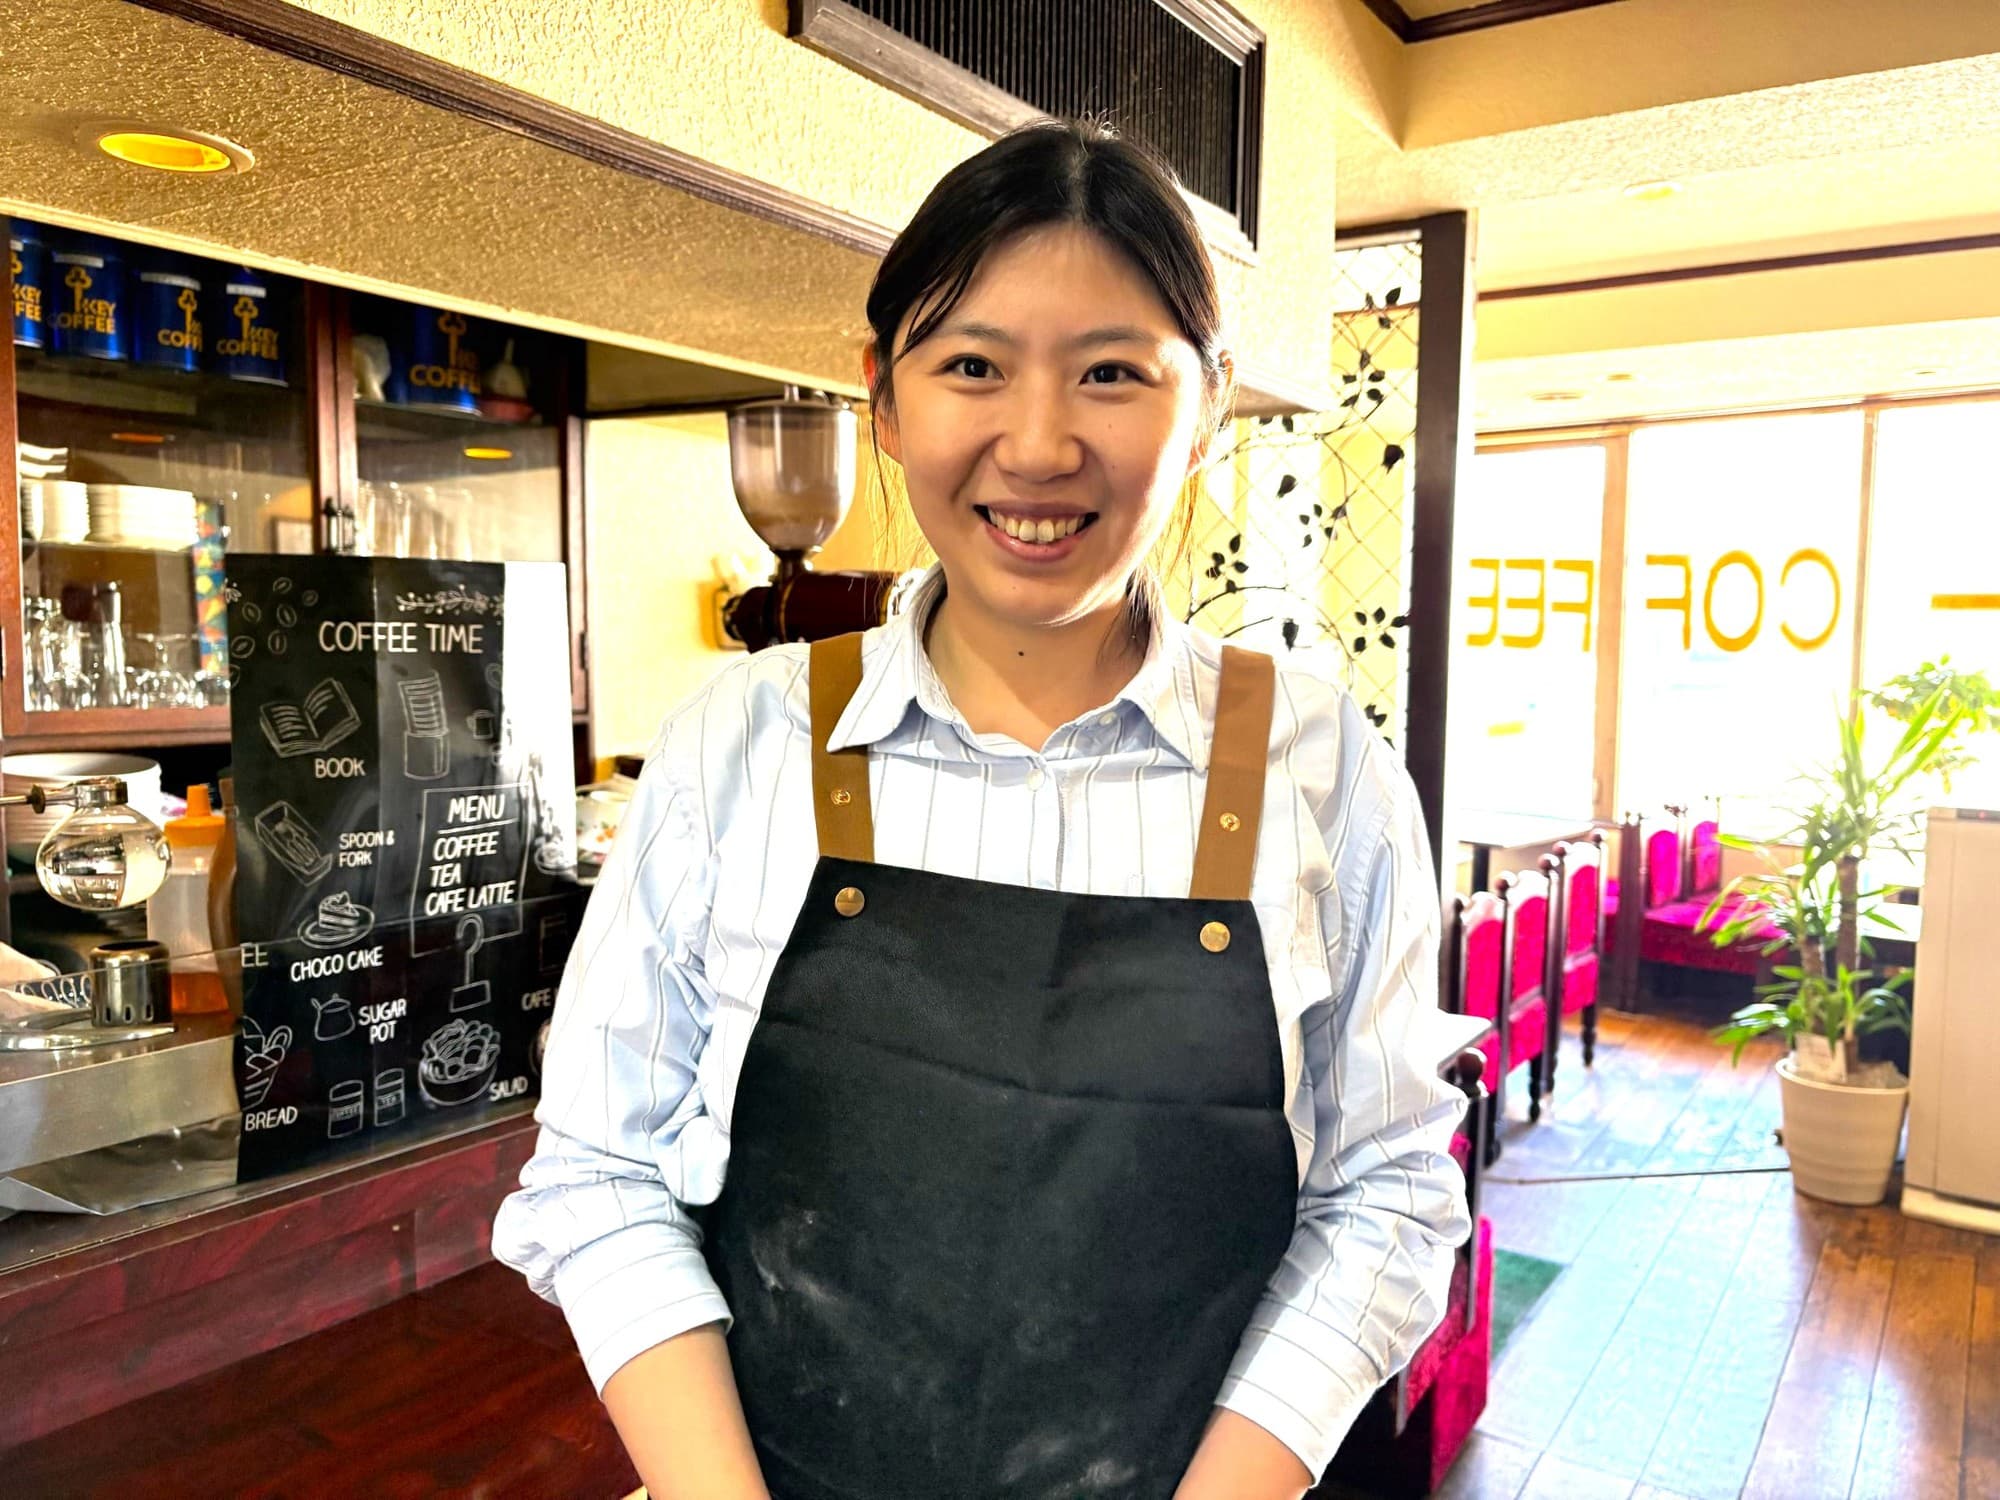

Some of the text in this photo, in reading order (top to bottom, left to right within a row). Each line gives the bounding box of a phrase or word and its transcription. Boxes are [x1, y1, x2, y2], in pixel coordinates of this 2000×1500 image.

[319, 621, 484, 653] COFFEE TIME
[314, 757, 366, 779] BOOK
[447, 793, 506, 824] MENU
[339, 829, 395, 849] SPOON &
[433, 831, 500, 862] COFFEE
[339, 850, 373, 867] FORK
[429, 862, 461, 888] TEA
[424, 879, 517, 917] CAFE LATTE
[290, 945, 384, 983] CHOCO CAKE
[358, 998, 407, 1026] SUGAR
[521, 987, 551, 1011] CAFE
[369, 1020, 398, 1045] POT
[489, 1076, 529, 1101] SALAD
[244, 1105, 299, 1132] BREAD
